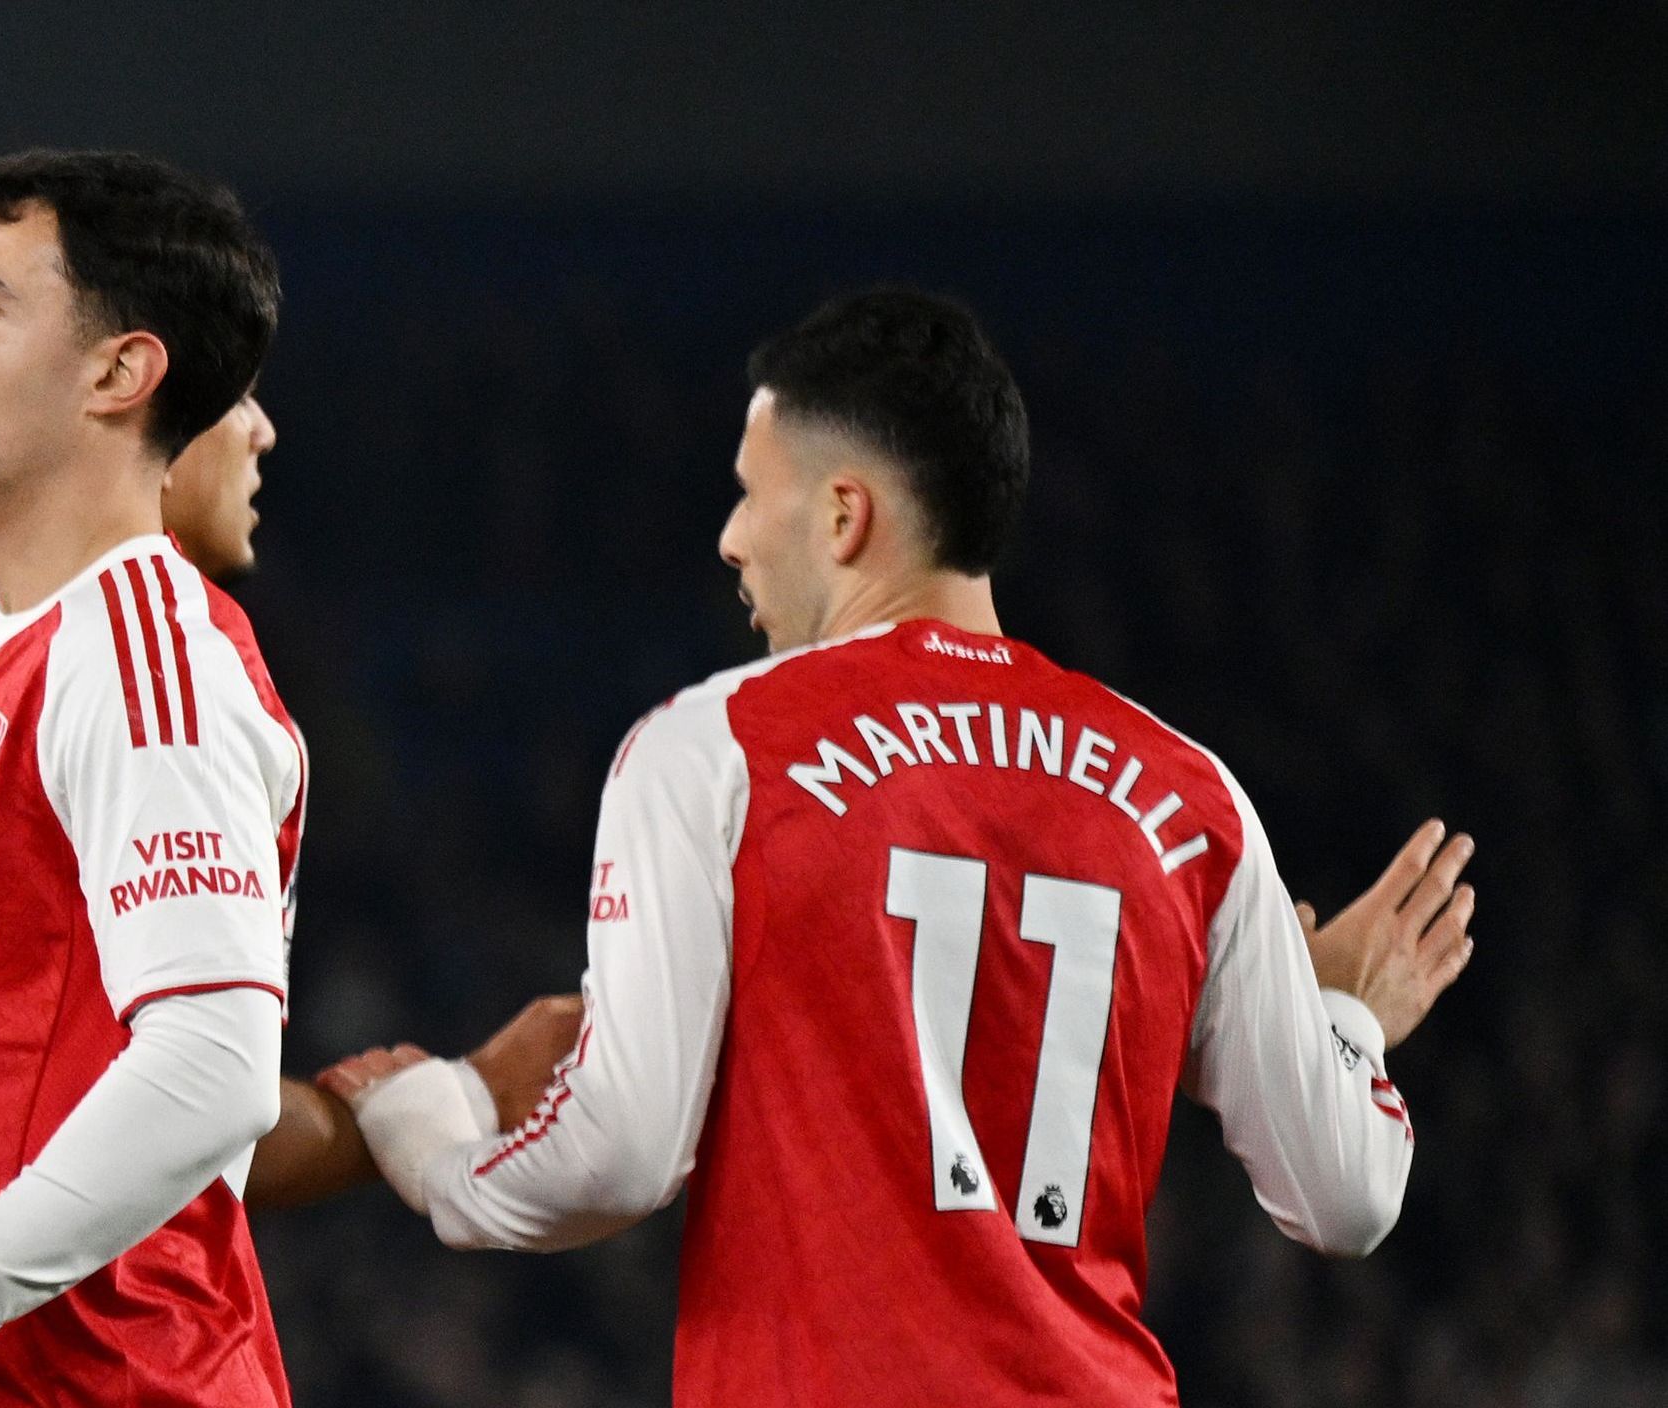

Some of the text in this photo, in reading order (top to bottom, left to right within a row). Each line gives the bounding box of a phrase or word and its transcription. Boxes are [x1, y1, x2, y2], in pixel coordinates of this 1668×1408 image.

[923, 631, 1013, 665] Arsenal
[786, 702, 1209, 875] MARTINELLI
[133, 831, 223, 866] VISIT
[110, 867, 265, 917] RWANDA
[885, 847, 1122, 1249] 11
